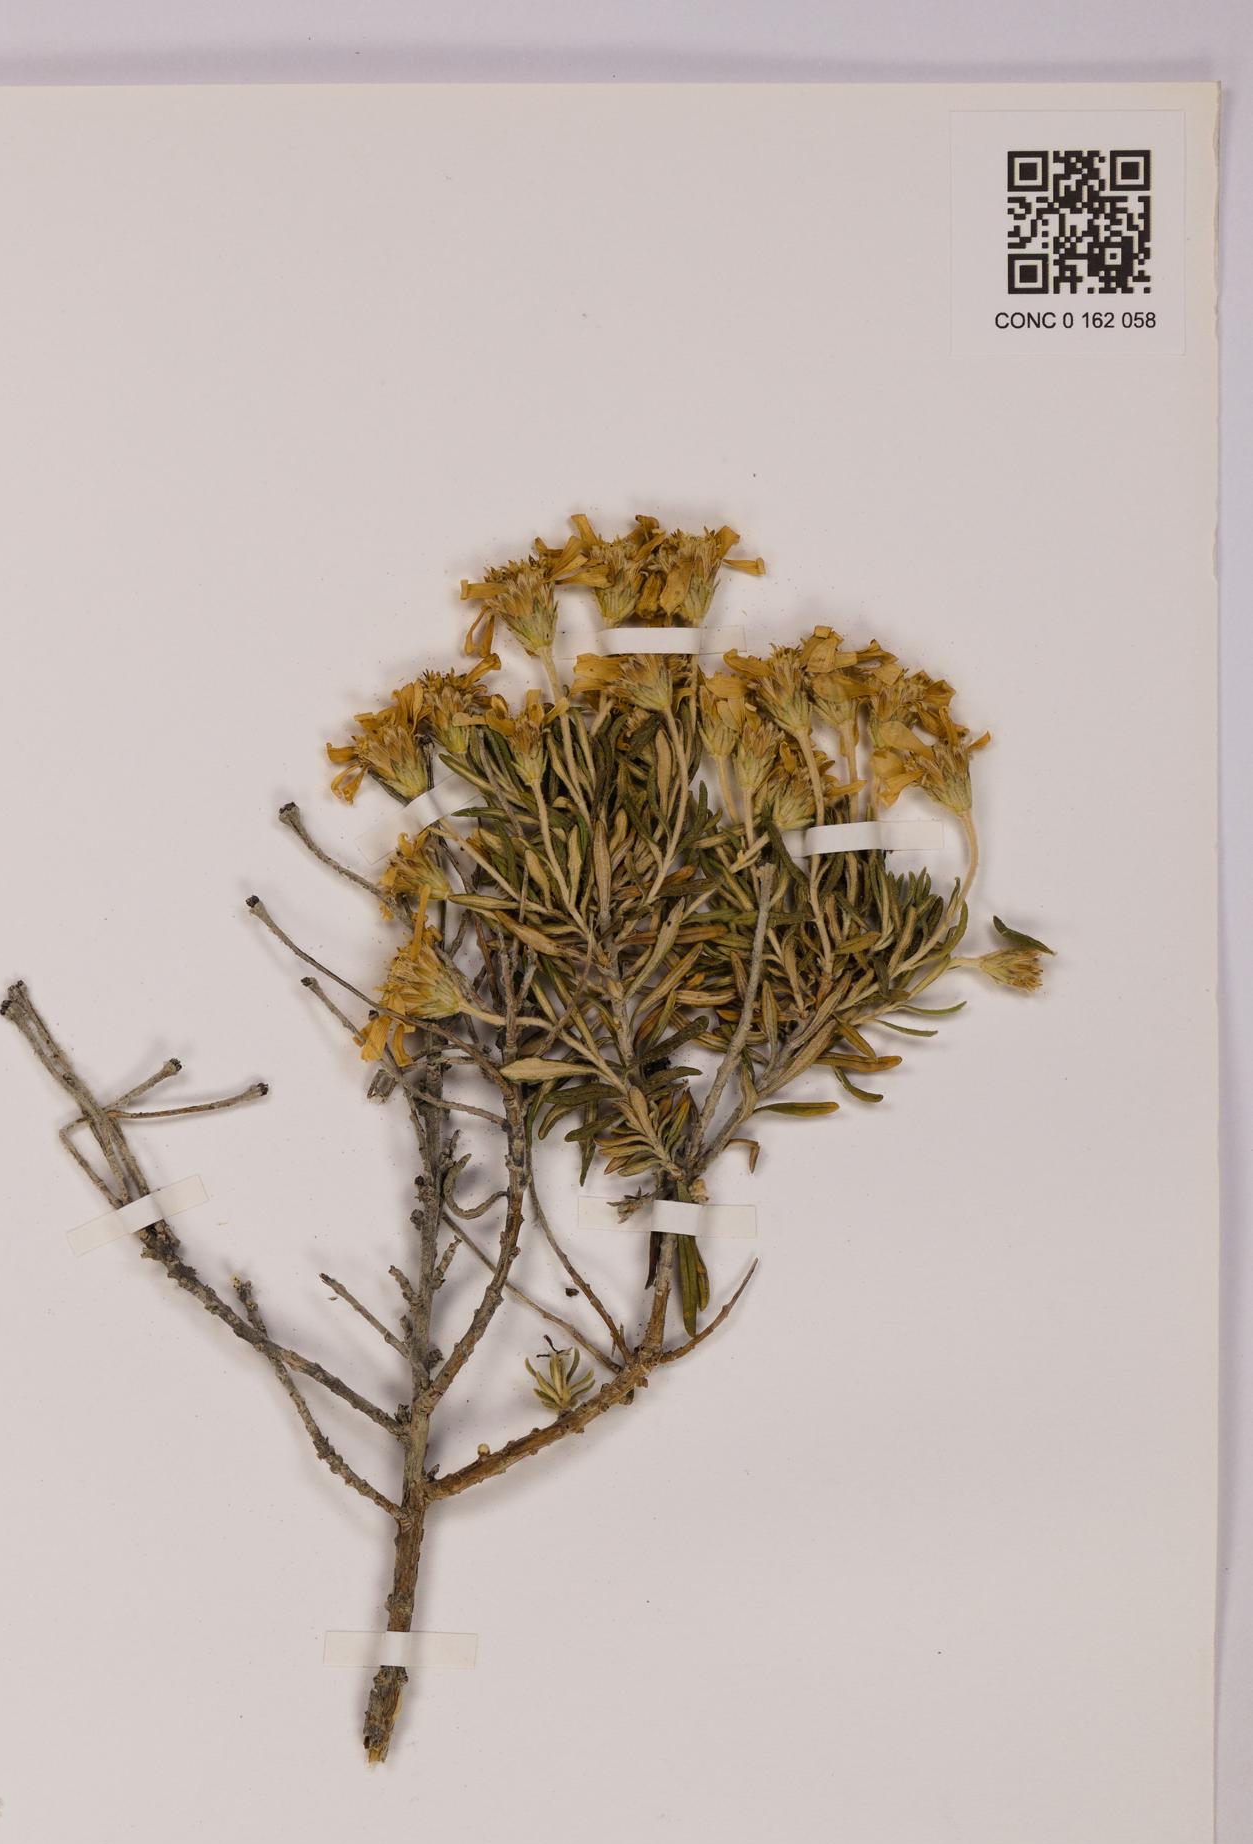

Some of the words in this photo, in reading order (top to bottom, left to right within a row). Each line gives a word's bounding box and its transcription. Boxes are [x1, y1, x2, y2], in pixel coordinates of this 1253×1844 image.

[994, 311, 1057, 330] CONC
[1062, 311, 1074, 329] 0
[1081, 311, 1115, 329] 162
[1121, 311, 1157, 329] 058
